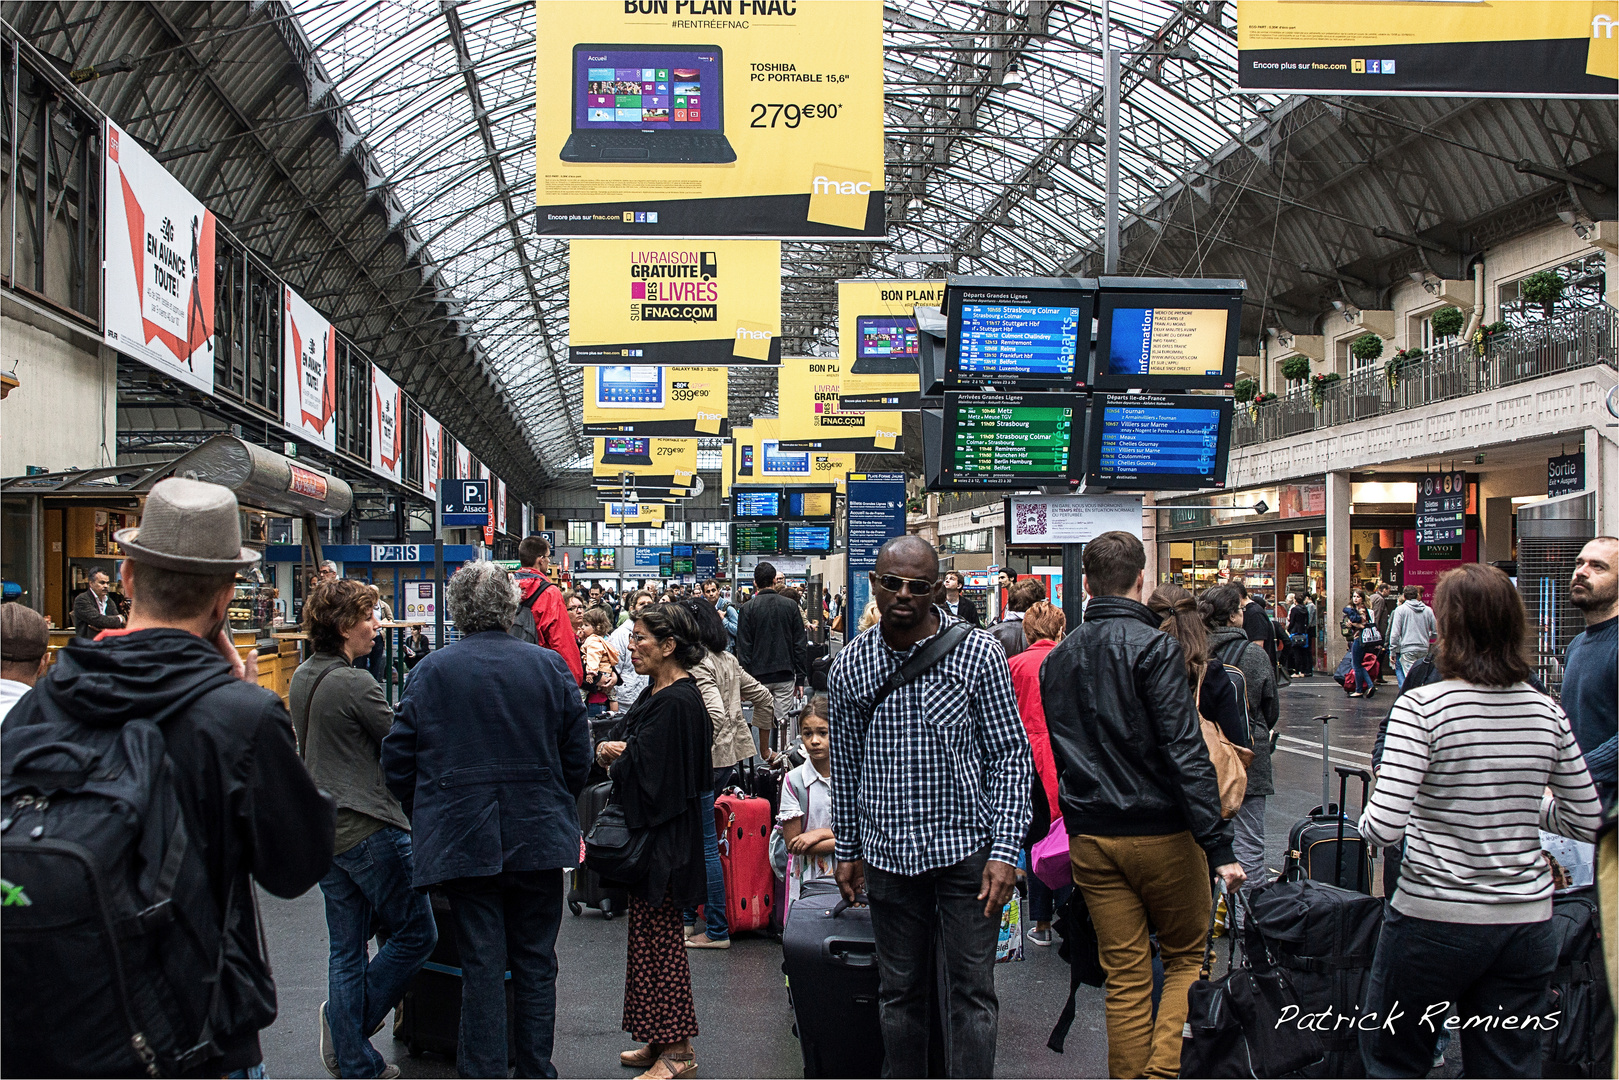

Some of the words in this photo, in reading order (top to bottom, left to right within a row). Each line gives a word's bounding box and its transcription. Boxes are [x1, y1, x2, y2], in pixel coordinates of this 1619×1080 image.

[624, 1, 668, 14] BON
[675, 1, 733, 15] PLAN
[740, 1, 797, 16] FNAC
[671, 19, 750, 29] #RENTRÉEFNAC
[750, 63, 796, 72] TOSHIBA
[1280, 62, 1297, 71] plus
[1311, 62, 1347, 70] fnac.com
[750, 73, 765, 82] PC
[767, 73, 822, 83] PORTABLE
[812, 175, 872, 196] fnac
[568, 214, 582, 222] plus
[147, 232, 158, 258] EN
[158, 242, 186, 279] AVANCE
[631, 251, 698, 264] LIVRAISON
[631, 265, 698, 278] GRATUITE
[647, 281, 657, 301] DES
[659, 281, 718, 302] LIVRES
[881, 290, 903, 301] BON
[906, 290, 934, 301] PLAN
[630, 303, 640, 321] SUR
[644, 308, 714, 318] FNAC.COM
[1002, 307, 1036, 315] Strasbourg
[735, 327, 773, 340] fnac
[1023, 333, 1051, 341] Chalindrey
[1057, 317, 1073, 373] départs
[1138, 309, 1153, 374] information
[809, 364, 826, 372] BON
[697, 411, 722, 421] fnac
[876, 429, 897, 438] fnac
[996, 433, 1028, 441] Strasbourg
[1051, 415, 1066, 472] arrivées
[1548, 460, 1576, 477] Sortie
[1560, 477, 1578, 485] Ausgang
[463, 505, 486, 513] Alsace
